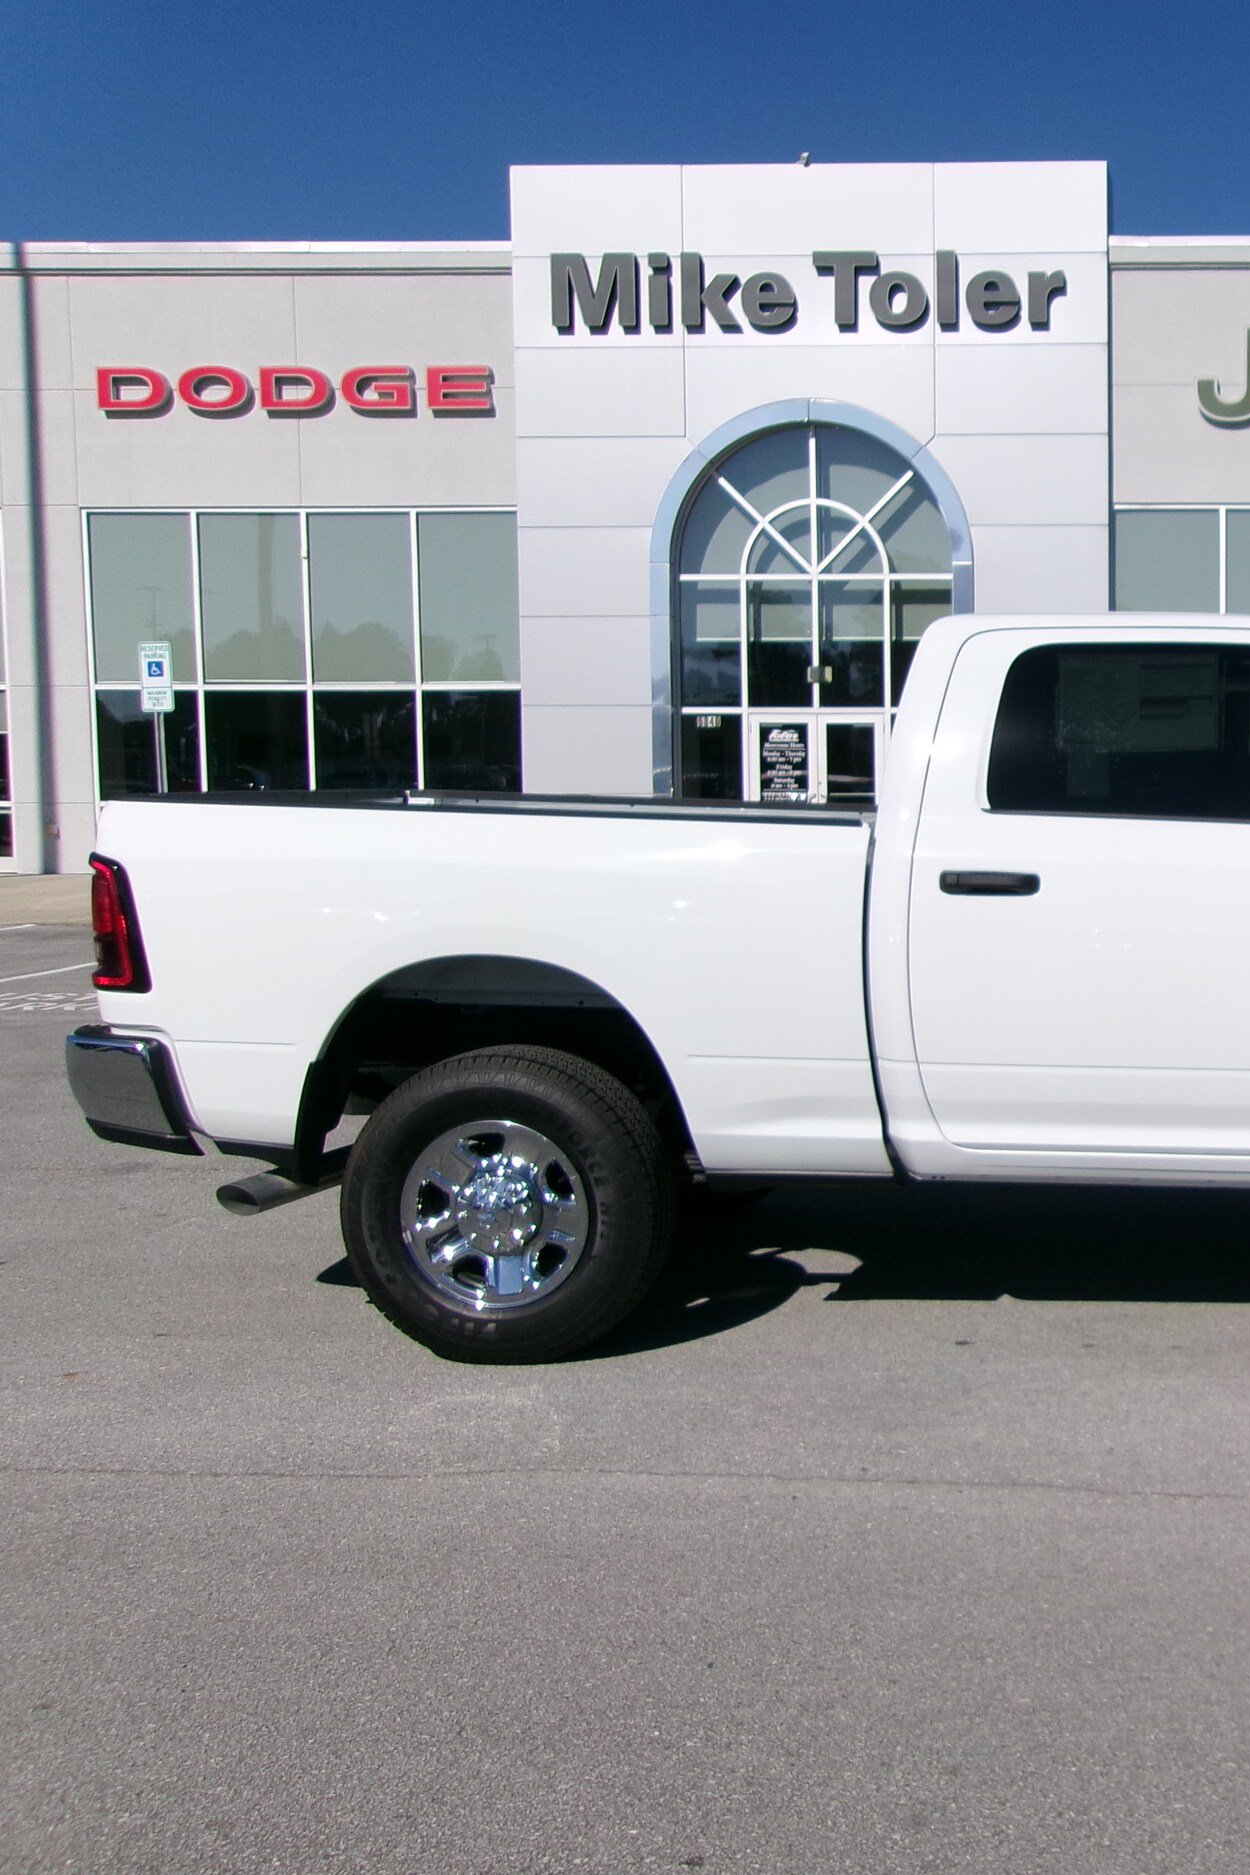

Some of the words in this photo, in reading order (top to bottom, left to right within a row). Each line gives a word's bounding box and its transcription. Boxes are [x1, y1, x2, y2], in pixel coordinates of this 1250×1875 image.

[550, 252, 799, 334] Mike
[812, 250, 1068, 334] Toler
[96, 364, 496, 419] DODGE
